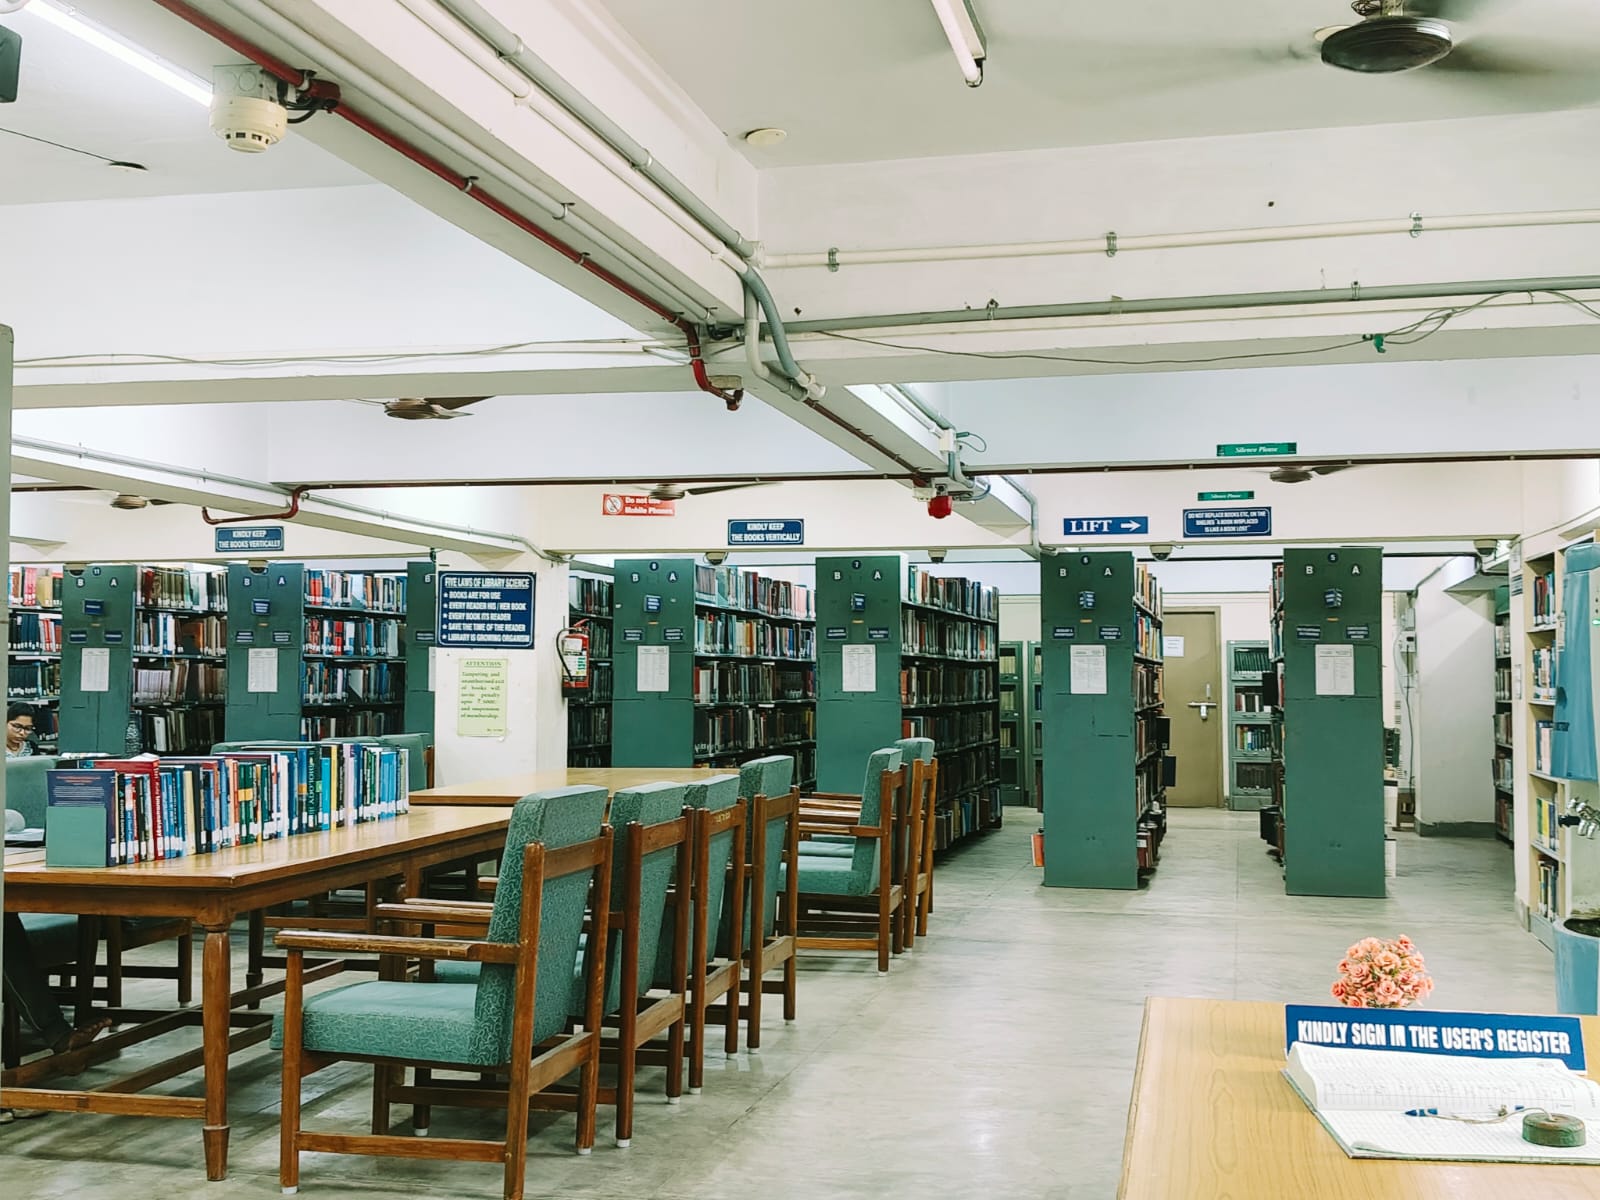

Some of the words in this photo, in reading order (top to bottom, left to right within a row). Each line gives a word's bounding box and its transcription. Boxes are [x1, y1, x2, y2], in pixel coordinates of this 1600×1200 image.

[625, 496, 635, 504] Do
[625, 506, 648, 514] Mobile
[746, 522, 768, 531] KINDLY
[768, 522, 785, 531] KEEP
[1069, 519, 1113, 533] LIFT
[232, 530, 251, 538] KINDLY
[252, 530, 267, 538] KEEP
[731, 533, 744, 542] THE
[744, 533, 765, 541] BOOKS
[765, 533, 801, 541] VERTICALLY
[218, 540, 230, 548] THE
[230, 540, 249, 548] BOOKS
[249, 540, 281, 548] VERTICALLY
[1059, 568, 1067, 577] B
[1104, 567, 1112, 576] A
[1305, 565, 1314, 575] B
[1352, 565, 1360, 575] A
[631, 573, 639, 582] B
[669, 572, 677, 581] A
[834, 571, 841, 580] B
[874, 571, 881, 580] A
[77, 578, 84, 587] B
[110, 578, 118, 587] A
[244, 577, 250, 586] B
[278, 576, 285, 585] A
[444, 577, 457, 587] FIVE
[457, 577, 473, 587] LAWS
[473, 577, 481, 588] OF
[481, 578, 505, 588] LIBRARY
[505, 578, 530, 589] SCIENCE
[449, 591, 468, 599] BOOKS
[468, 591, 480, 599] ARE
[479, 591, 490, 600] FOR
[490, 591, 502, 600] USE
[448, 601, 466, 610] EVERY
[466, 601, 487, 610] READER
[487, 602, 497, 610] HIS
[500, 602, 511, 610] HER
[511, 602, 527, 611] BOOK
[448, 612, 465, 620] EVERY
[465, 612, 480, 620] BOOK
[480, 612, 490, 620] ITS
[490, 612, 512, 621] READER
[448, 622, 462, 630] SAVE
[462, 622, 473, 631] THE
[473, 623, 486, 631] TIME
[486, 623, 494, 631] OF
[494, 623, 504, 631] THE
[504, 624, 526, 632] READER
[447, 633, 470, 641] LIBRARY
[470, 633, 476, 641] IS
[476, 634, 502, 642] GROWING
[502, 634, 530, 642] ORGANISM
[1297, 1020, 1348, 1044] KINDLY
[1351, 1022, 1386, 1046] SIGN
[1390, 1024, 1405, 1047] IN
[1408, 1025, 1440, 1049] THE
[1441, 1027, 1494, 1051] USER'S
[1496, 1029, 1571, 1054] REGISTER
